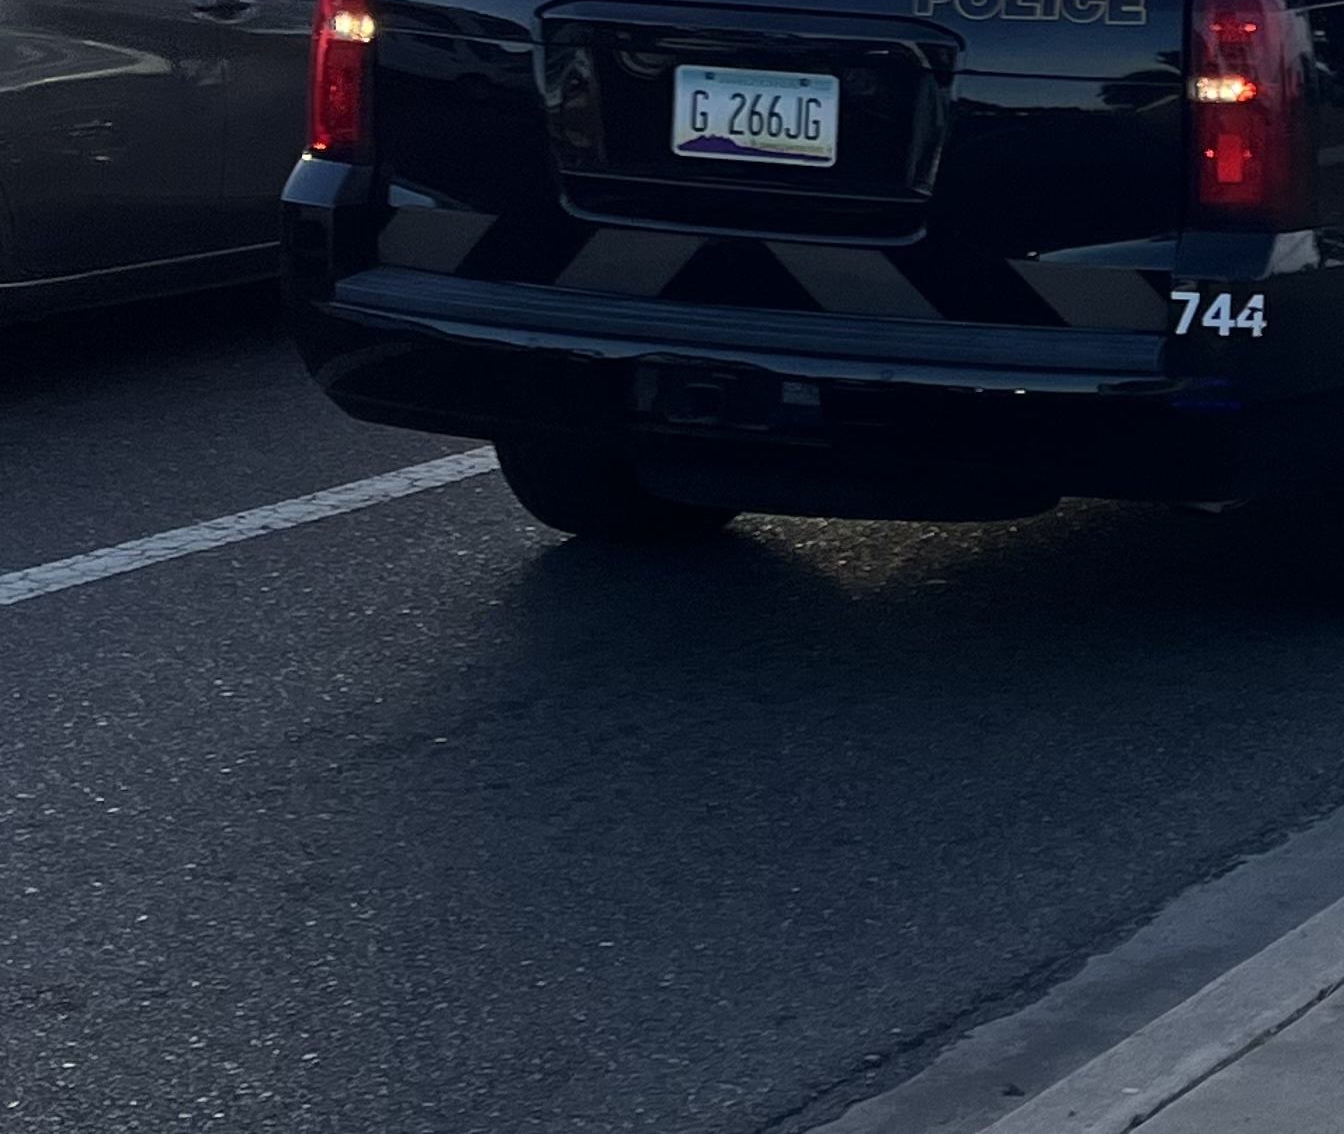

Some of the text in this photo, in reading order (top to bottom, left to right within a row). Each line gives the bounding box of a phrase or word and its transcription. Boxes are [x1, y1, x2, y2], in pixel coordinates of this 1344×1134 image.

[692, 89, 822, 140] G 266JG
[1170, 290, 1268, 337] 744
